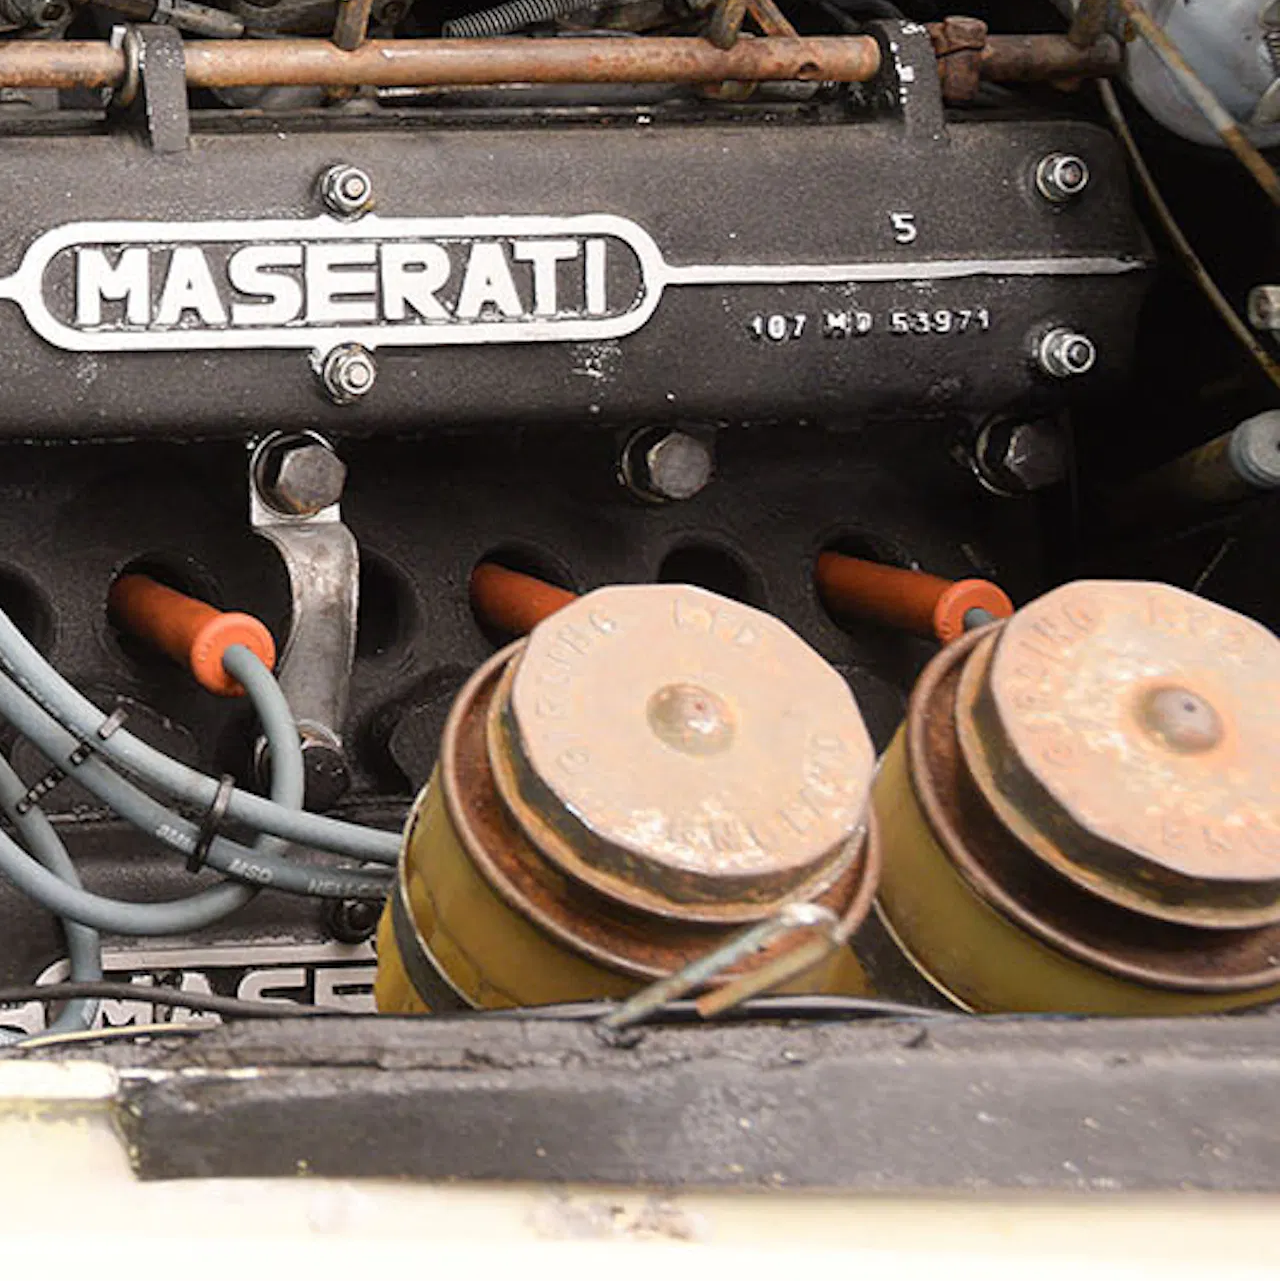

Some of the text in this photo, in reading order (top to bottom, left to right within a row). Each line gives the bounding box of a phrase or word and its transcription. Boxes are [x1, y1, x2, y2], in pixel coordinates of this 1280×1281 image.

[890, 211, 918, 244] 5
[73, 237, 609, 326] MASERATI
[890, 308, 991, 334] 53971
[228, 857, 276, 885] MSD
